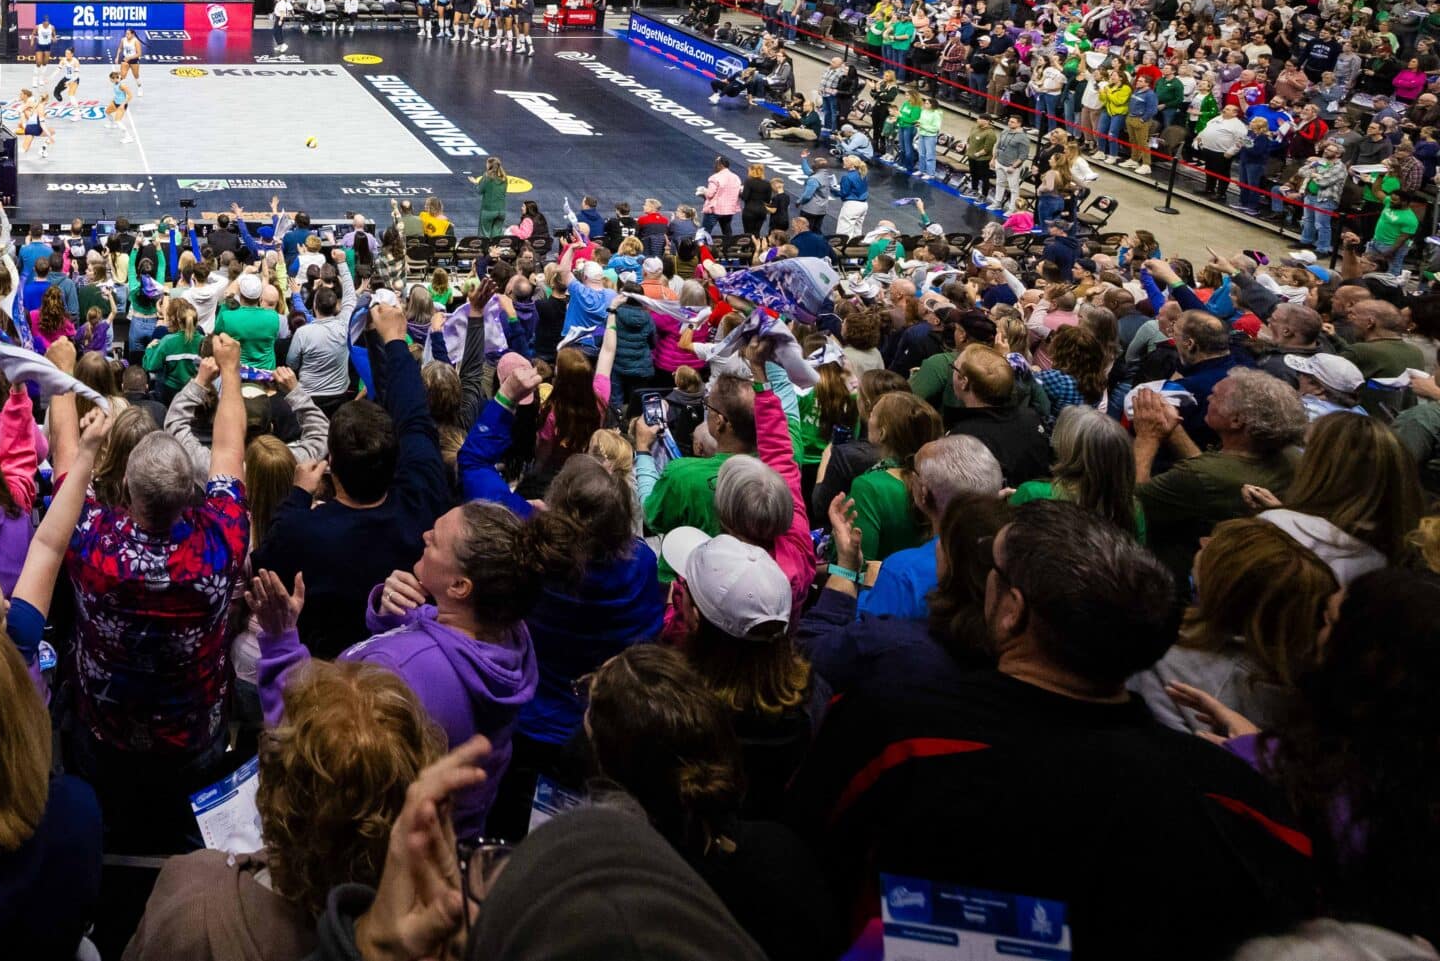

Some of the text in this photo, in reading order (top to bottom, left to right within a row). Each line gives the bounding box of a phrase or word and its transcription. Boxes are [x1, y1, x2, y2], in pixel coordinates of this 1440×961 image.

[102, 5, 146, 20] PROTEIN
[631, 18, 715, 65] BudgetNebraska.com
[213, 68, 338, 77] Kiewit
[579, 62, 715, 127] major league
[364, 74, 489, 157] SUPERNOVAS
[46, 182, 145, 192] BOOMER!
[340, 187, 434, 195] ROYALTY
